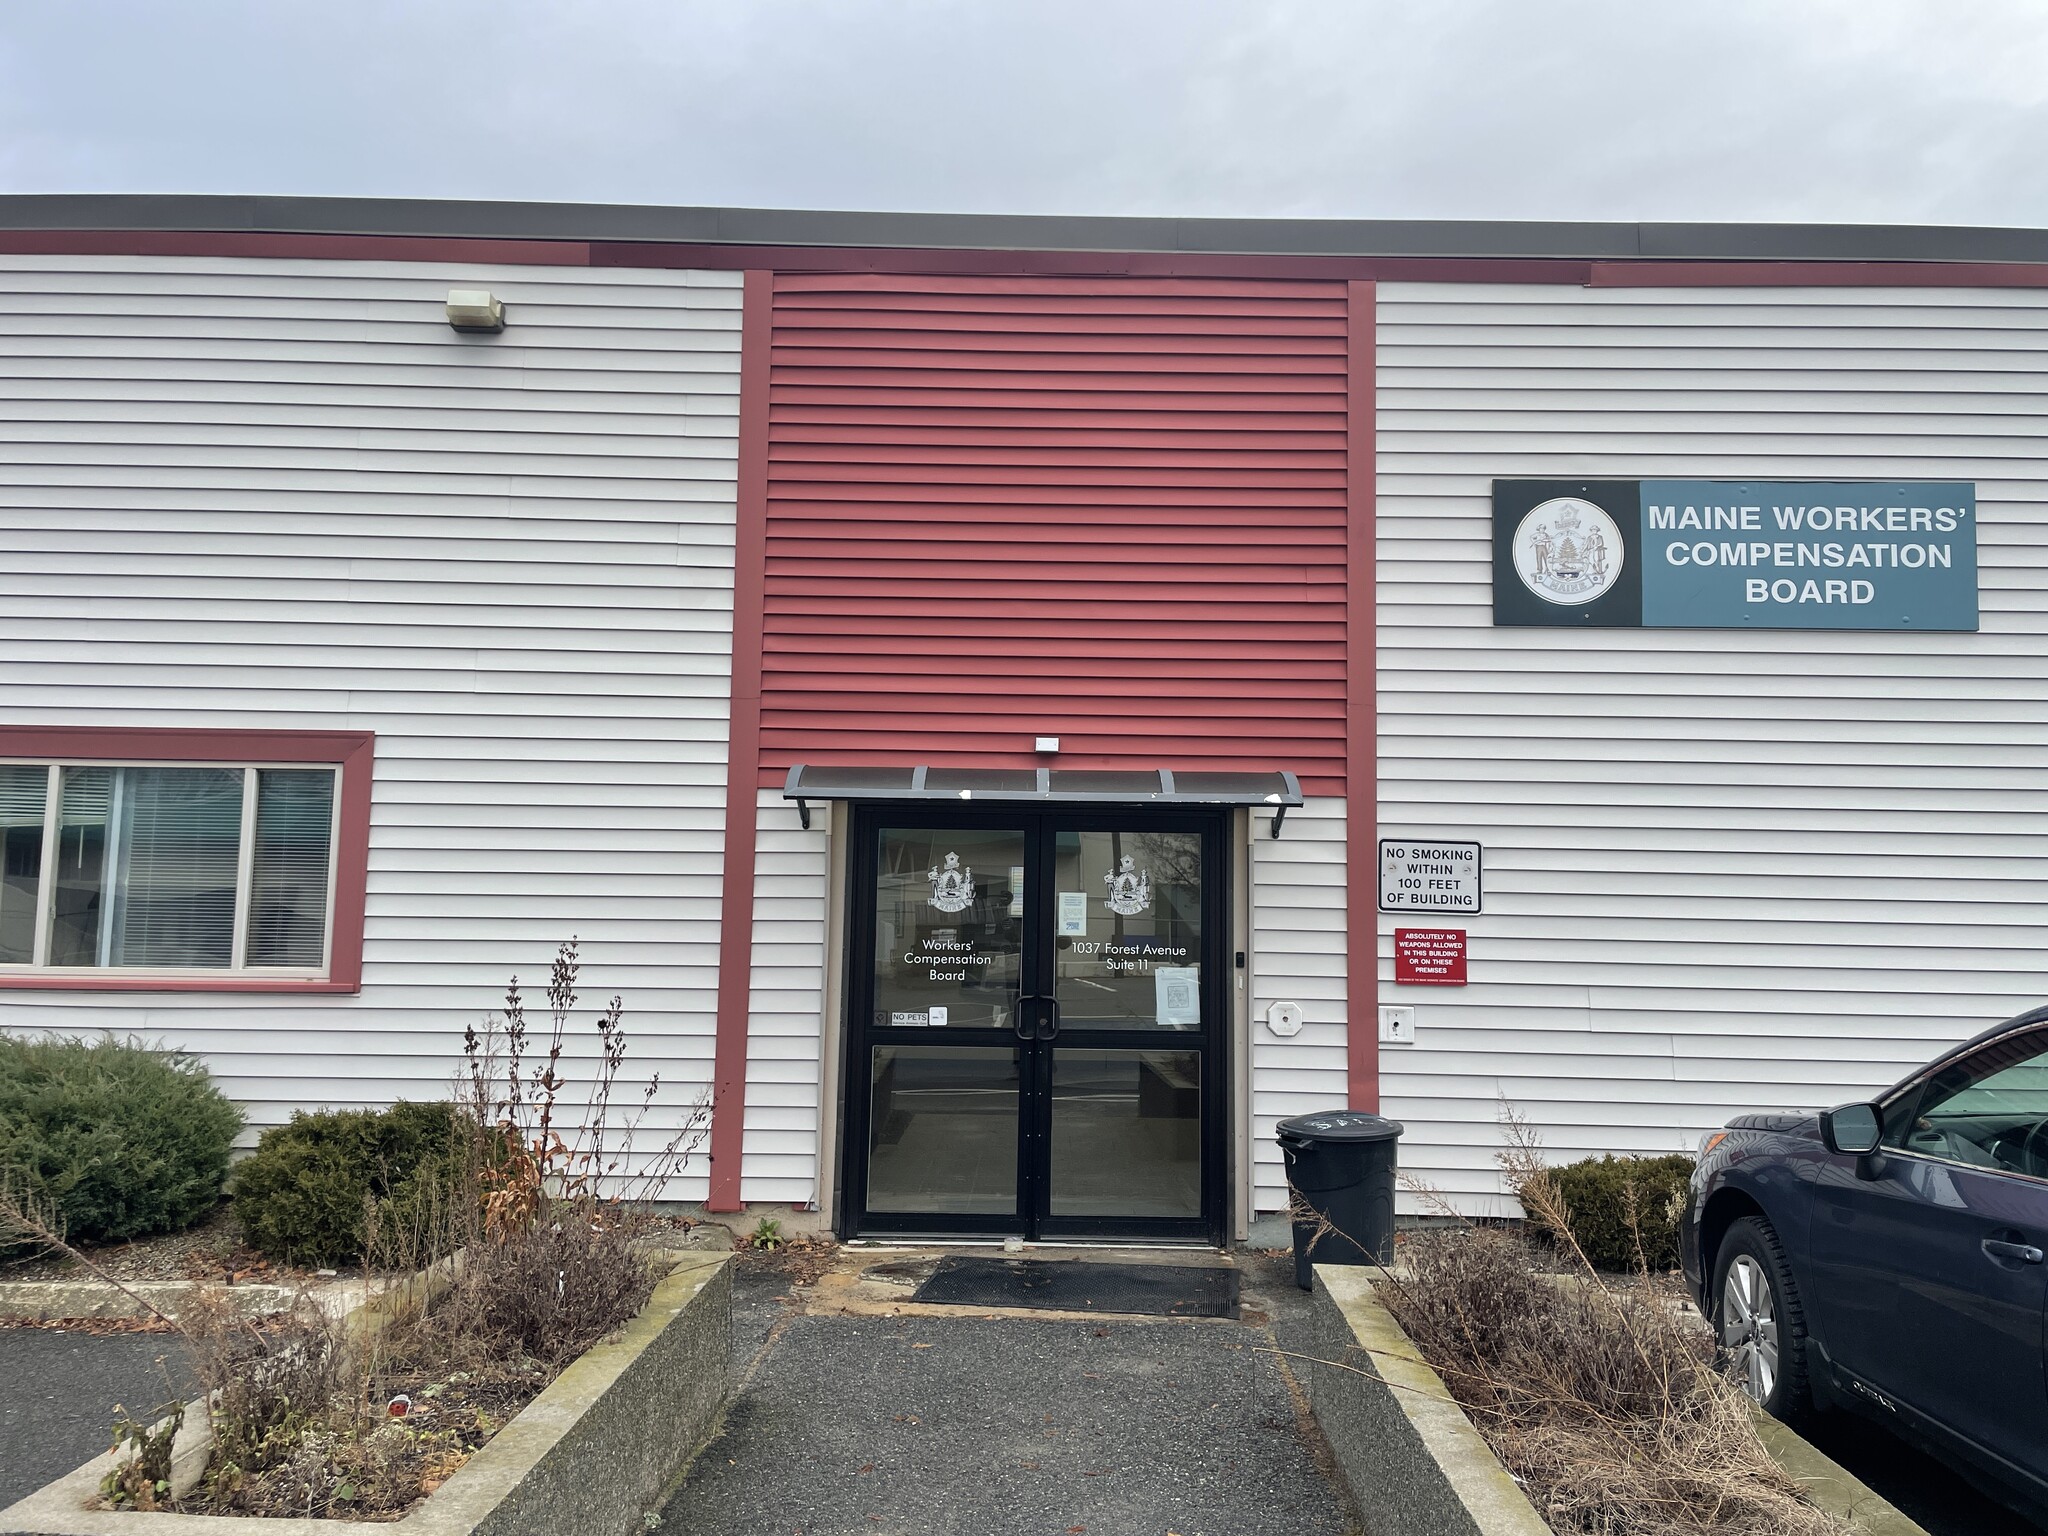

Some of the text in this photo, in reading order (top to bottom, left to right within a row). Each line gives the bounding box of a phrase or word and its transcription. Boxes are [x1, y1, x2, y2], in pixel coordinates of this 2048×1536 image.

[1648, 505, 1967, 532] MAINE WORKERS'
[1665, 541, 1952, 568] COMPENSATION
[1746, 579, 1875, 605] BOARD
[1386, 848, 1473, 861] NO SMOKING
[1407, 864, 1453, 875] WITHIN
[1398, 879, 1461, 890] 100 FEET
[1387, 893, 1473, 906] OF BUILDING
[922, 939, 974, 951] Workers'
[1072, 942, 1187, 956] 1037 Forest Avenue
[904, 953, 991, 967] Compensation
[1106, 958, 1149, 970] Suite 11
[929, 969, 965, 981] Board
[907, 1013, 927, 1021] PETS
